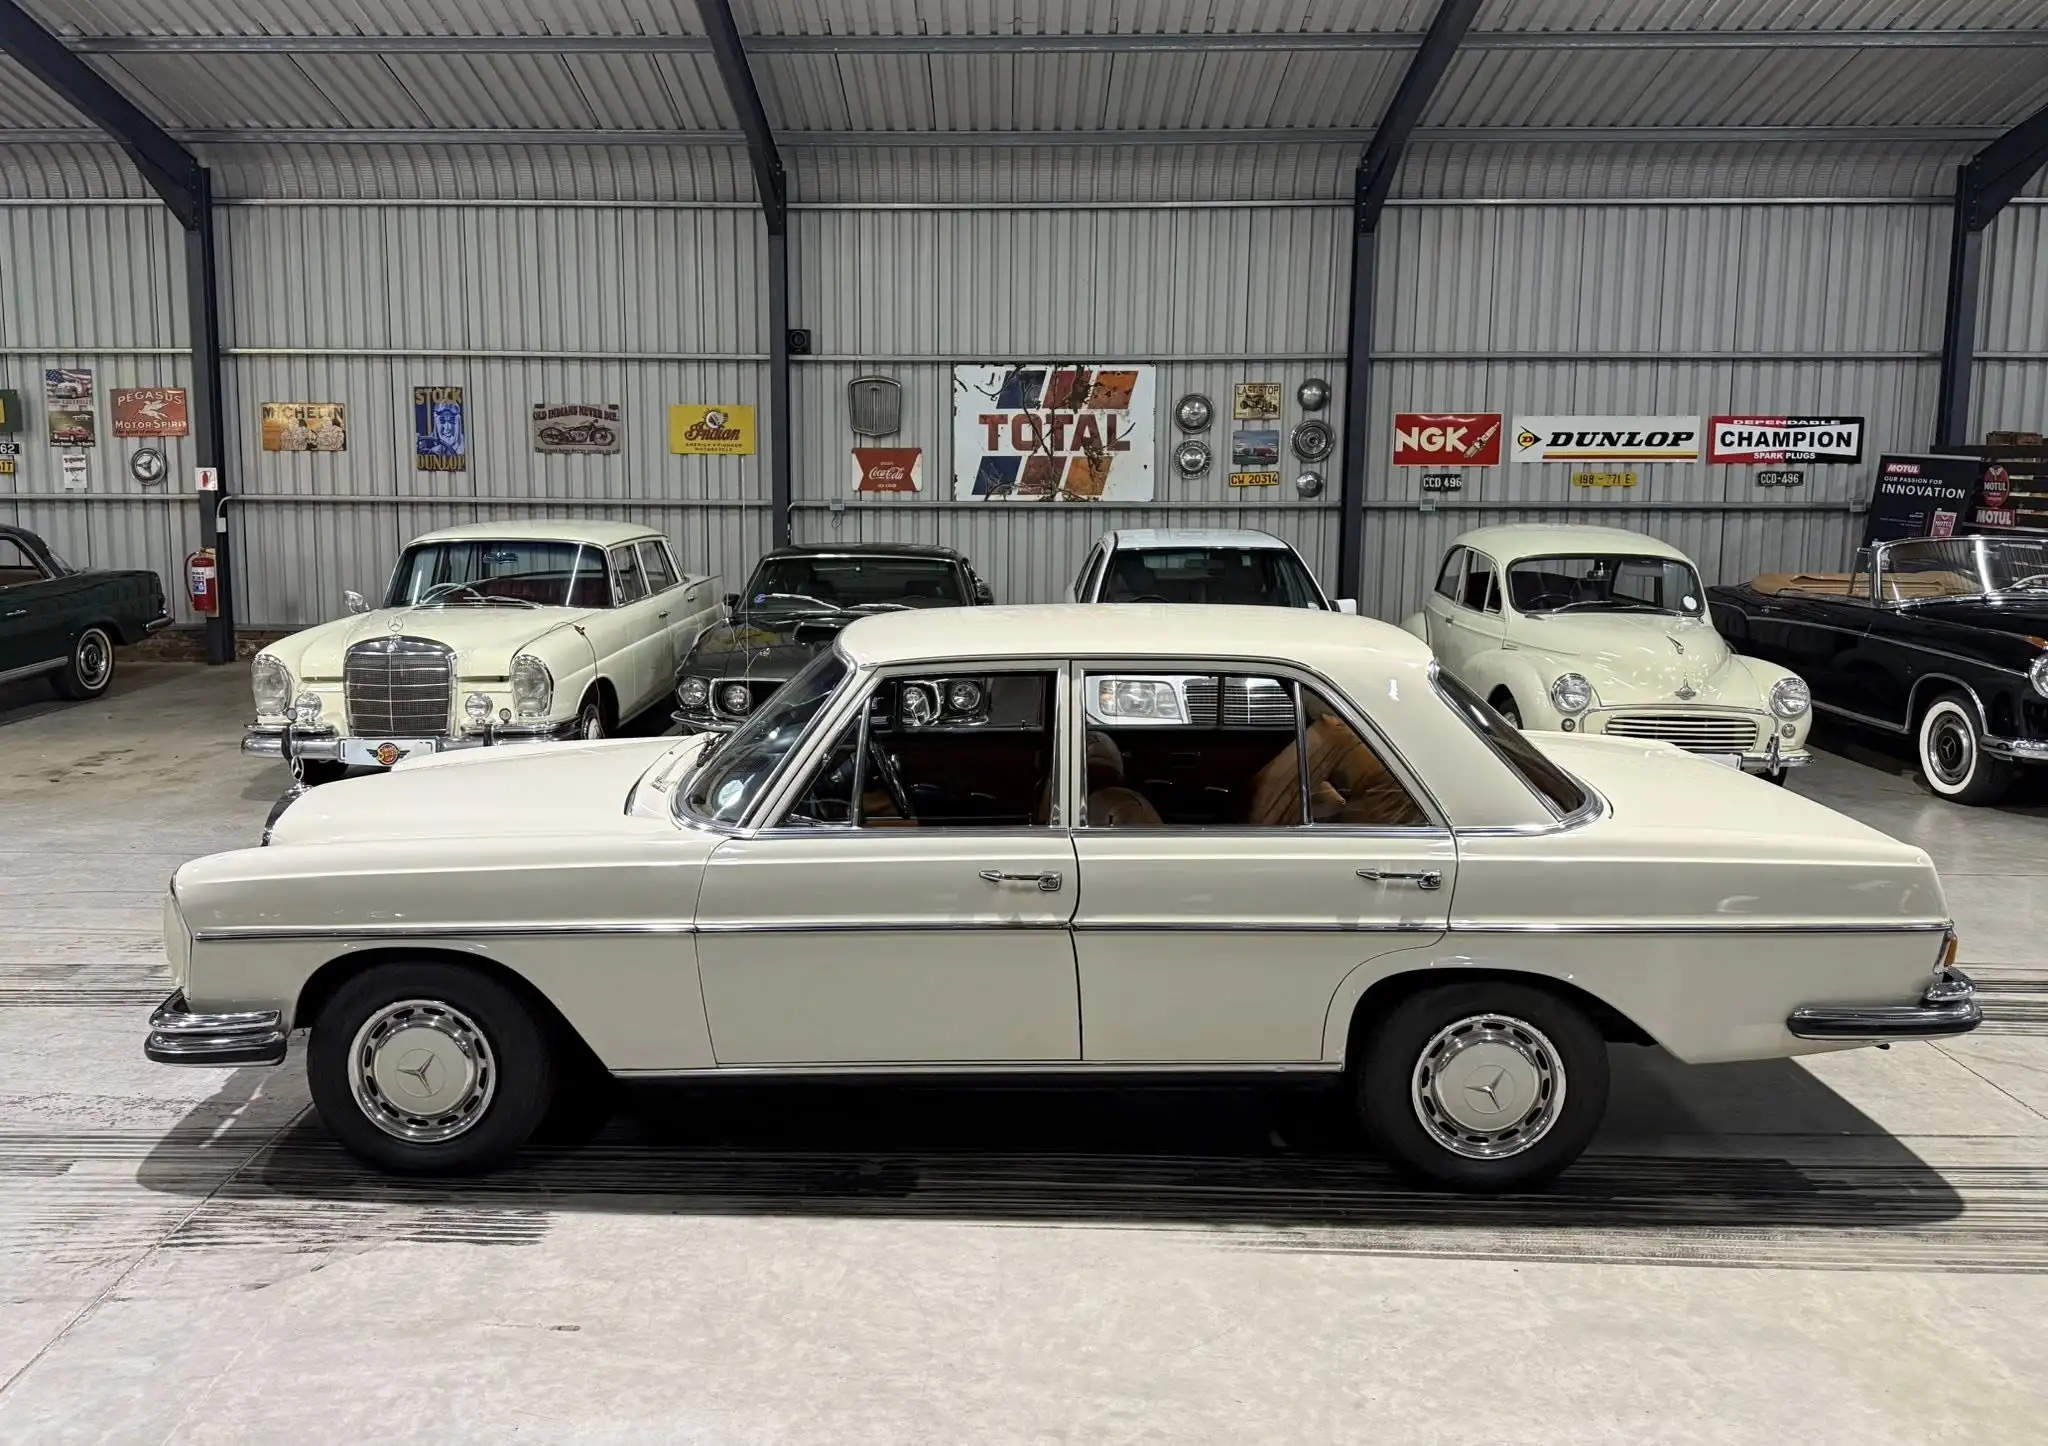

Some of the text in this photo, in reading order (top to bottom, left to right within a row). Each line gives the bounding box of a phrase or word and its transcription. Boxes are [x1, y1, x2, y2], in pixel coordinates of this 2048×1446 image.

[415, 388, 462, 405] STOCK
[1237, 385, 1279, 395] LAST STOP
[117, 391, 183, 406] PEGASUS
[262, 406, 343, 419] MICHELIN
[533, 410, 547, 420] OLD
[115, 419, 187, 429] MOTOR SPIRIT
[684, 421, 740, 441] Indian
[978, 413, 1131, 451] TOTAL
[1546, 431, 1694, 447] DUNLOP
[1720, 430, 1852, 448] CHAMPION
[1395, 426, 1468, 453] NGK
[417, 455, 465, 470] DUNLOP
[1753, 452, 1815, 460] SPARK PLUGS
[1887, 464, 1920, 474] MOTUL
[1249, 474, 1278, 484] 20314
[1423, 478, 1462, 487] CCD 496
[1760, 473, 1799, 484] CCD-496
[1881, 484, 1966, 500] INNOVATION
[1983, 482, 2007, 492] MOTUL
[1976, 509, 2012, 525] MOTUL
